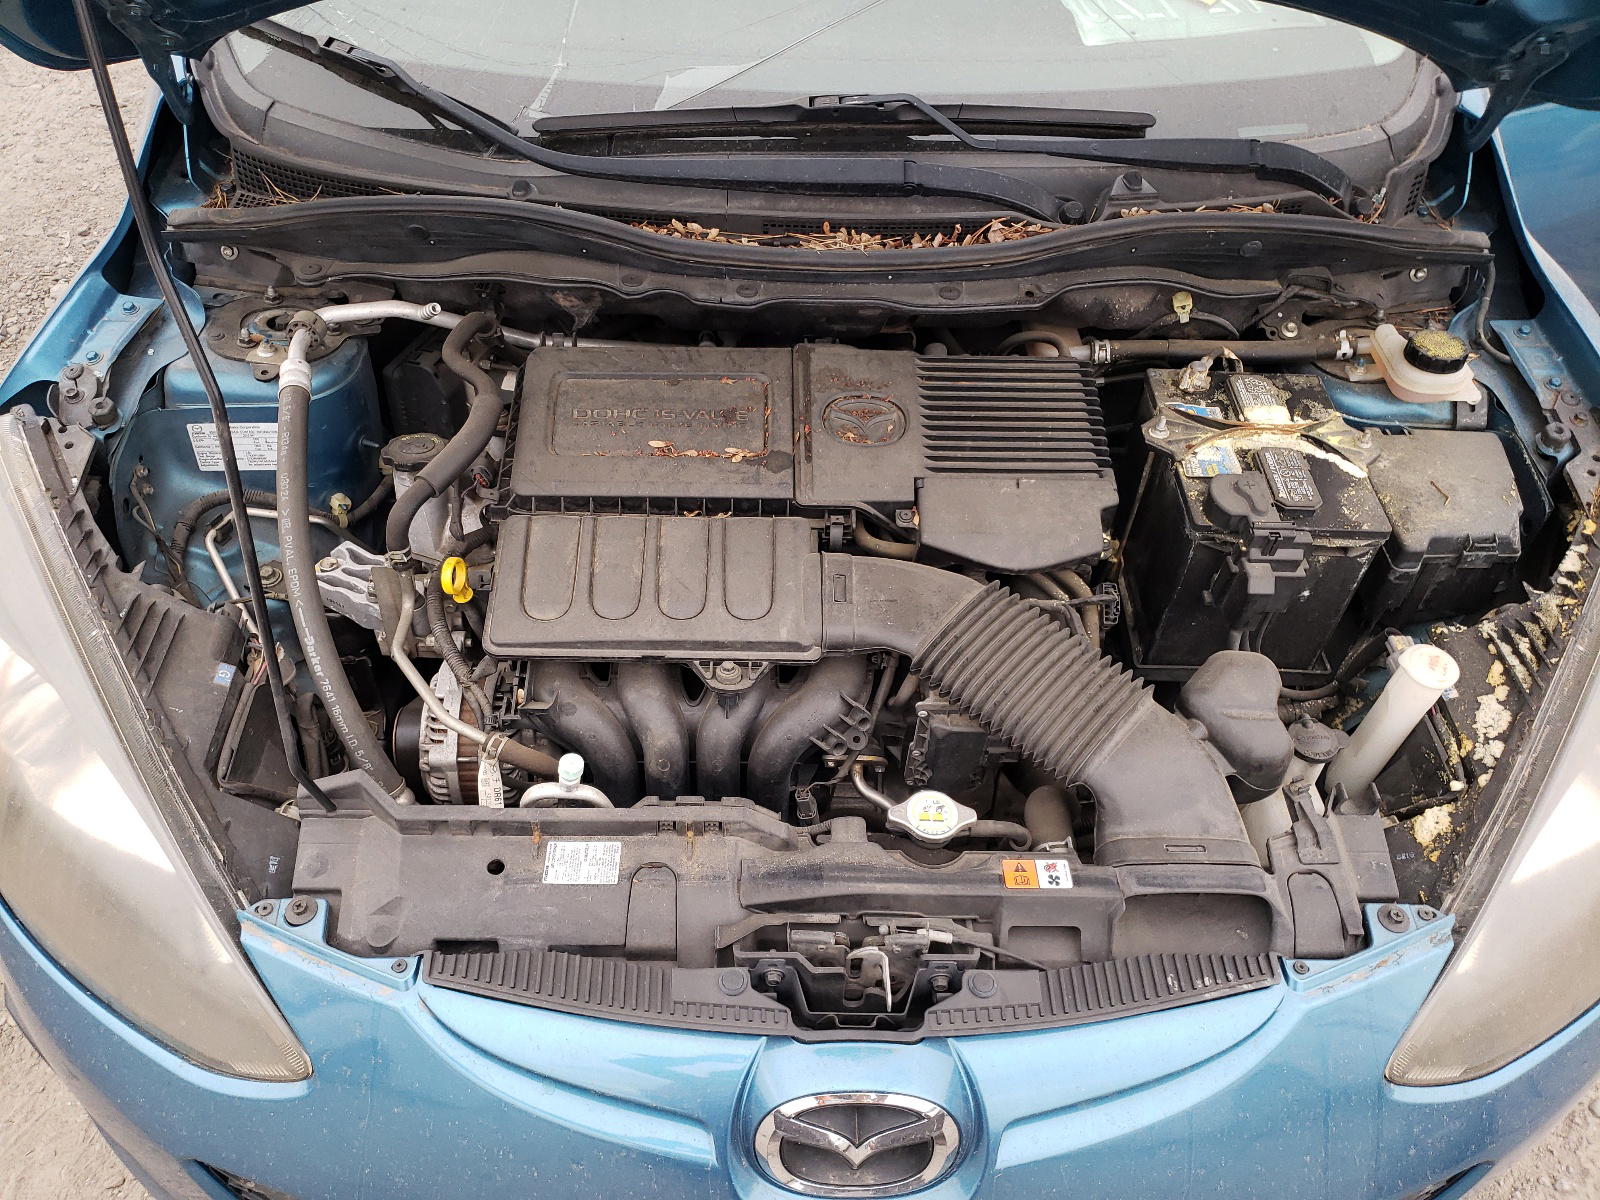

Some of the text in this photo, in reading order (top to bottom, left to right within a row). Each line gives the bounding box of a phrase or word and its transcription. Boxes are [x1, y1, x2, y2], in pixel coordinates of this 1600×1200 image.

[319, 679, 336, 702] 7641
[331, 704, 349, 735] 16mm
[493, 786, 502, 805] DR61
